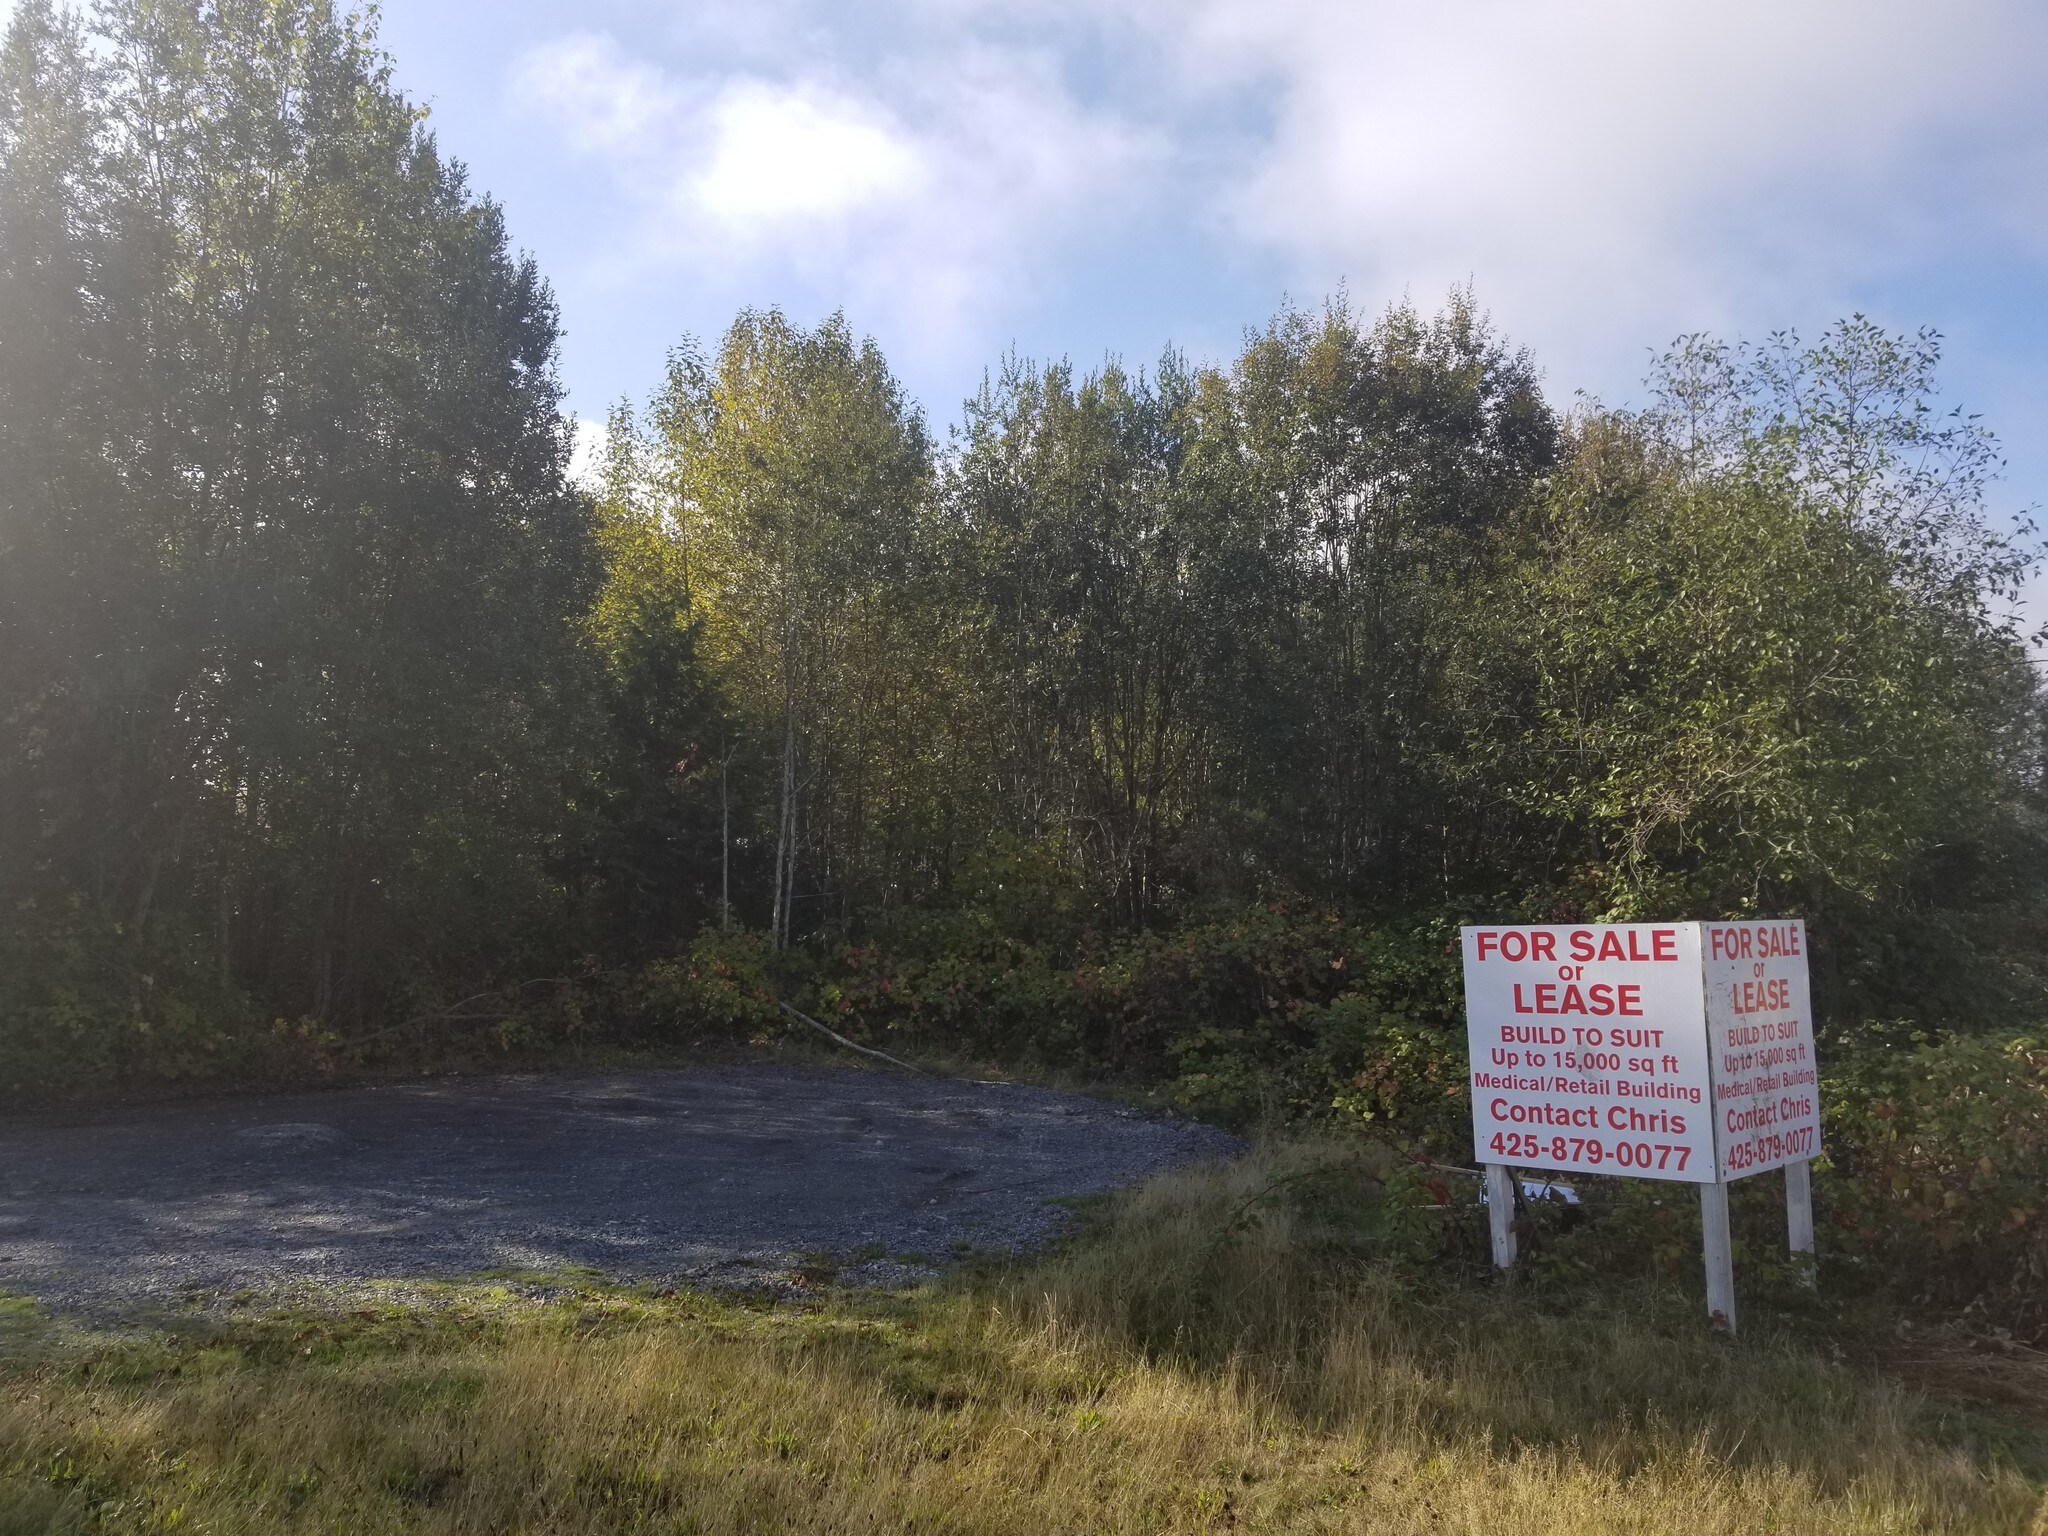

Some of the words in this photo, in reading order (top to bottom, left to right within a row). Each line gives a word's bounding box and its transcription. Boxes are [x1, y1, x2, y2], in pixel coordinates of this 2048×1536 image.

[1476, 930, 1557, 962] FOR
[1569, 930, 1679, 962] SALE
[1711, 928, 1753, 960] FOR
[1757, 926, 1800, 958] SALE
[1558, 964, 1584, 981] or
[1753, 962, 1765, 979] or
[1513, 984, 1644, 1016] LEASE
[1733, 979, 1790, 1014] LEASE
[1501, 1026, 1566, 1045] BUILD
[1572, 1028, 1603, 1047] TO
[1610, 1029, 1664, 1048] SUIT
[1728, 1026, 1760, 1048] BUILD
[1761, 1024, 1776, 1042] TO
[1778, 1020, 1799, 1039] SUIT
[1491, 1048, 1519, 1072] Up
[1525, 1051, 1546, 1068] to
[1554, 1052, 1620, 1073] 15,000
[1628, 1057, 1655, 1076] sq
[1661, 1056, 1679, 1073] ft
[1724, 1054, 1739, 1075] Up
[1739, 1053, 1752, 1070] to
[1754, 1047, 1784, 1069] 15,000
[1785, 1048, 1797, 1065] sq
[1798, 1043, 1806, 1060] ft
[1475, 1072, 1610, 1096] Medical/Retail
[1617, 1080, 1702, 1104] Building
[1717, 1075, 1781, 1100] Medical/Retail
[1783, 1069, 1815, 1087] Building
[1490, 1098, 1598, 1128] Contact
[1608, 1106, 1687, 1134] Chris
[1727, 1102, 1778, 1133] Contact
[1780, 1095, 1811, 1120] Chris
[1490, 1132, 1692, 1171] 425-879-0077
[1728, 1126, 1813, 1170] 425-879-0077
